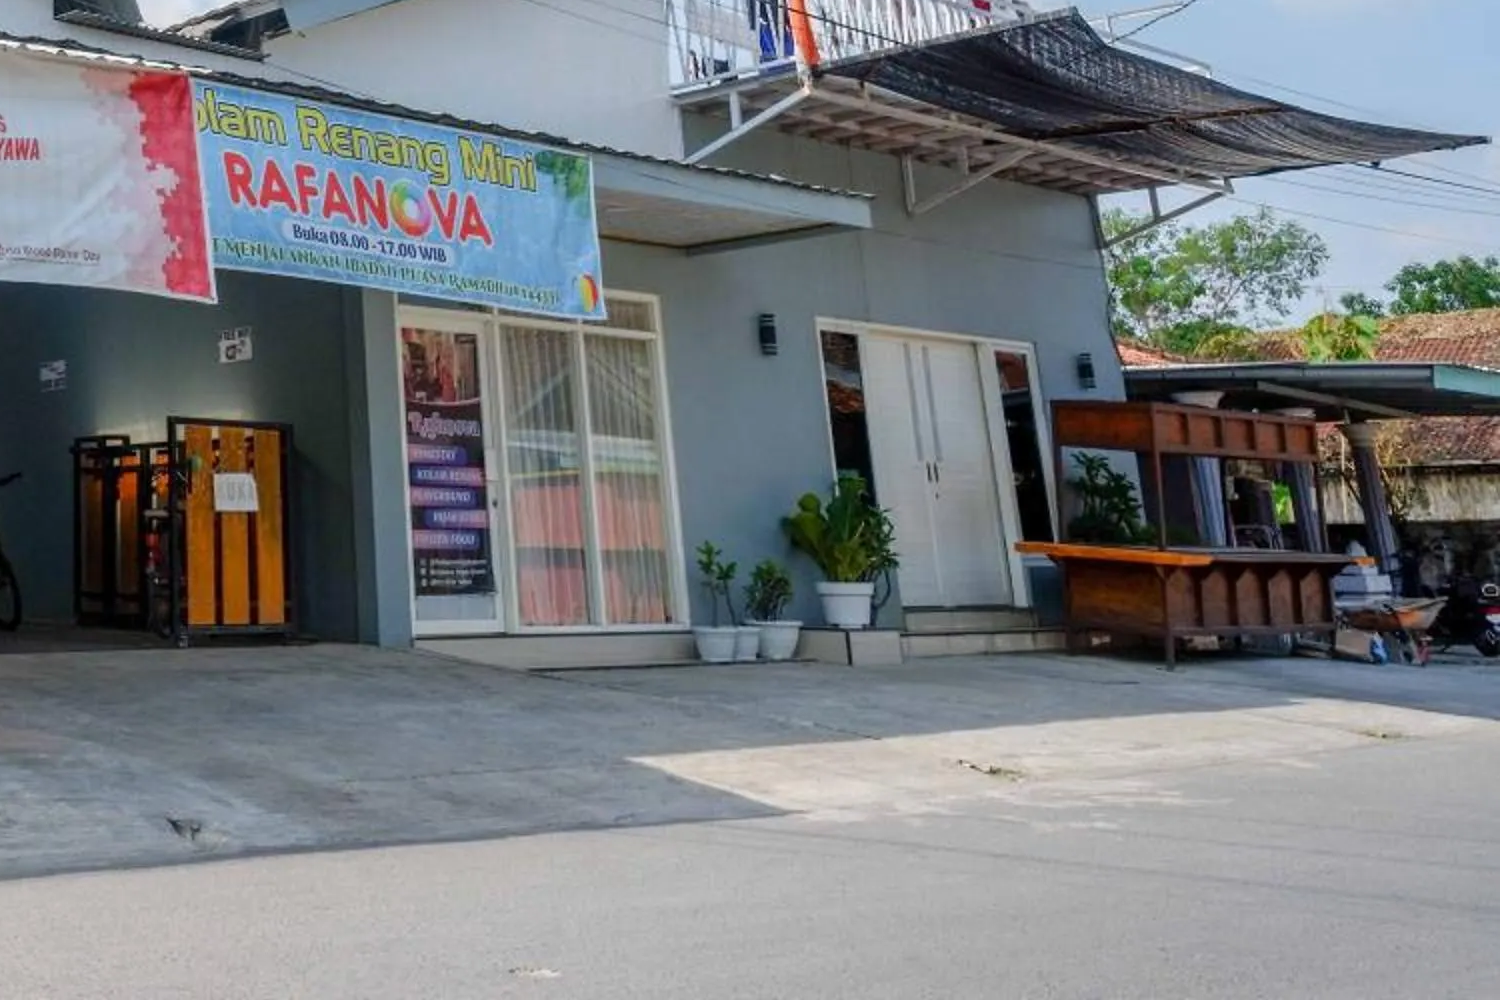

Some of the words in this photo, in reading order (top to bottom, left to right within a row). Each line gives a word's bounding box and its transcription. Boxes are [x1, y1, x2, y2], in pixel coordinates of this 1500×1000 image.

[295, 104, 451, 186] Renang
[457, 135, 538, 192] Mini
[223, 151, 494, 246] RAFANOVA
[292, 223, 328, 243] Buka
[418, 245, 447, 263] WIB
